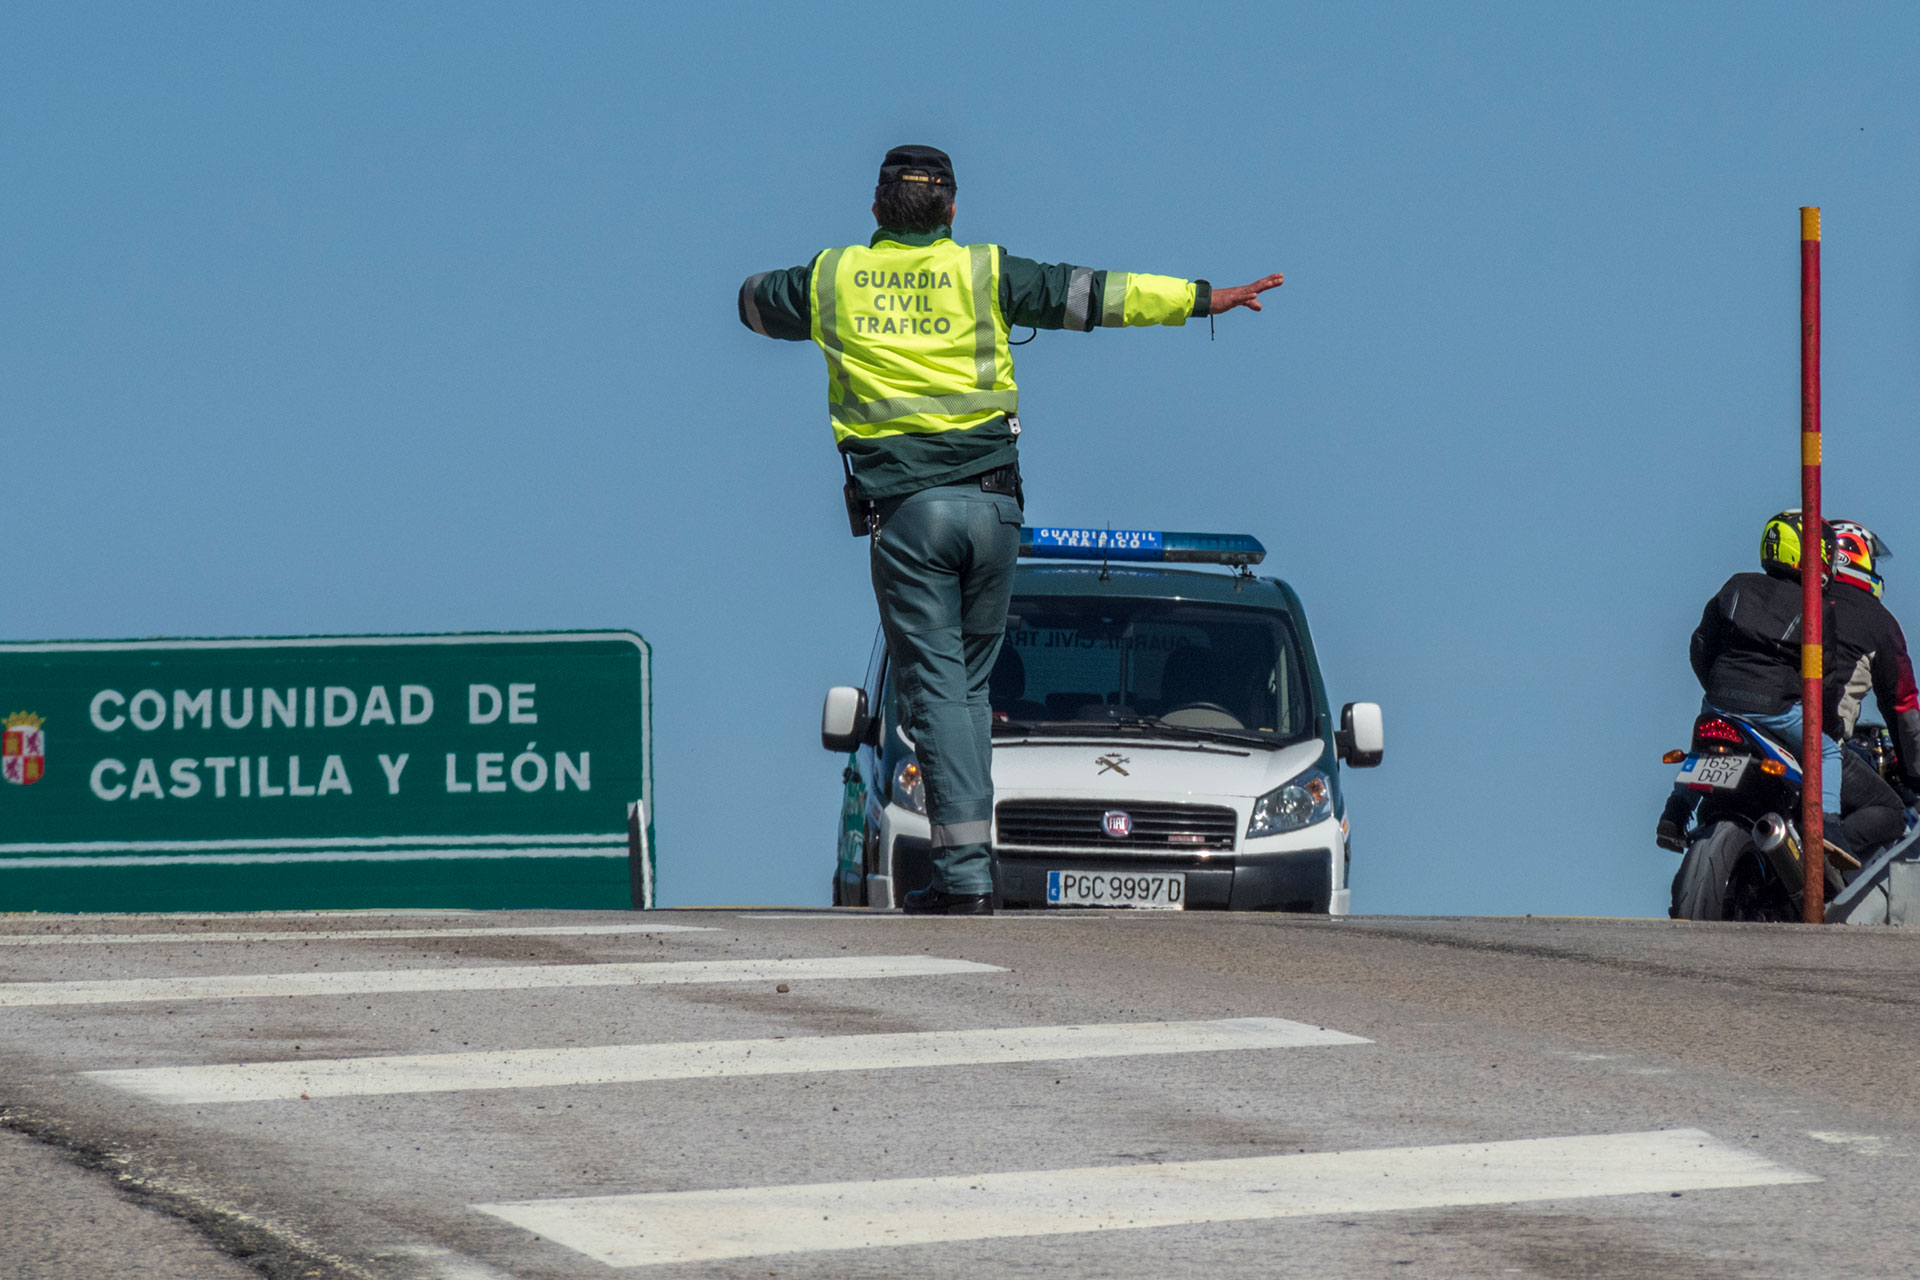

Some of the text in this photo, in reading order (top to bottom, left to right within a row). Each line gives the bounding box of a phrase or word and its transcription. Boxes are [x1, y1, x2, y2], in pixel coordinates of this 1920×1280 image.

[854, 270, 952, 289] GUARDIA
[874, 294, 933, 312] CIVIL
[855, 317, 951, 335] TRAFICO
[1041, 529, 1156, 542] GUARDIA CIVIL
[1057, 537, 1141, 549] TRAFICO
[89, 683, 539, 732] COMUNIDAD DE
[89, 741, 591, 801] CASTILLA Y LEÓN
[1698, 768, 1735, 784] DDY
[1109, 817, 1126, 830] FIAT
[1063, 874, 1105, 899] PGC
[1109, 876, 1164, 901] 9997
[1168, 878, 1182, 902] D
